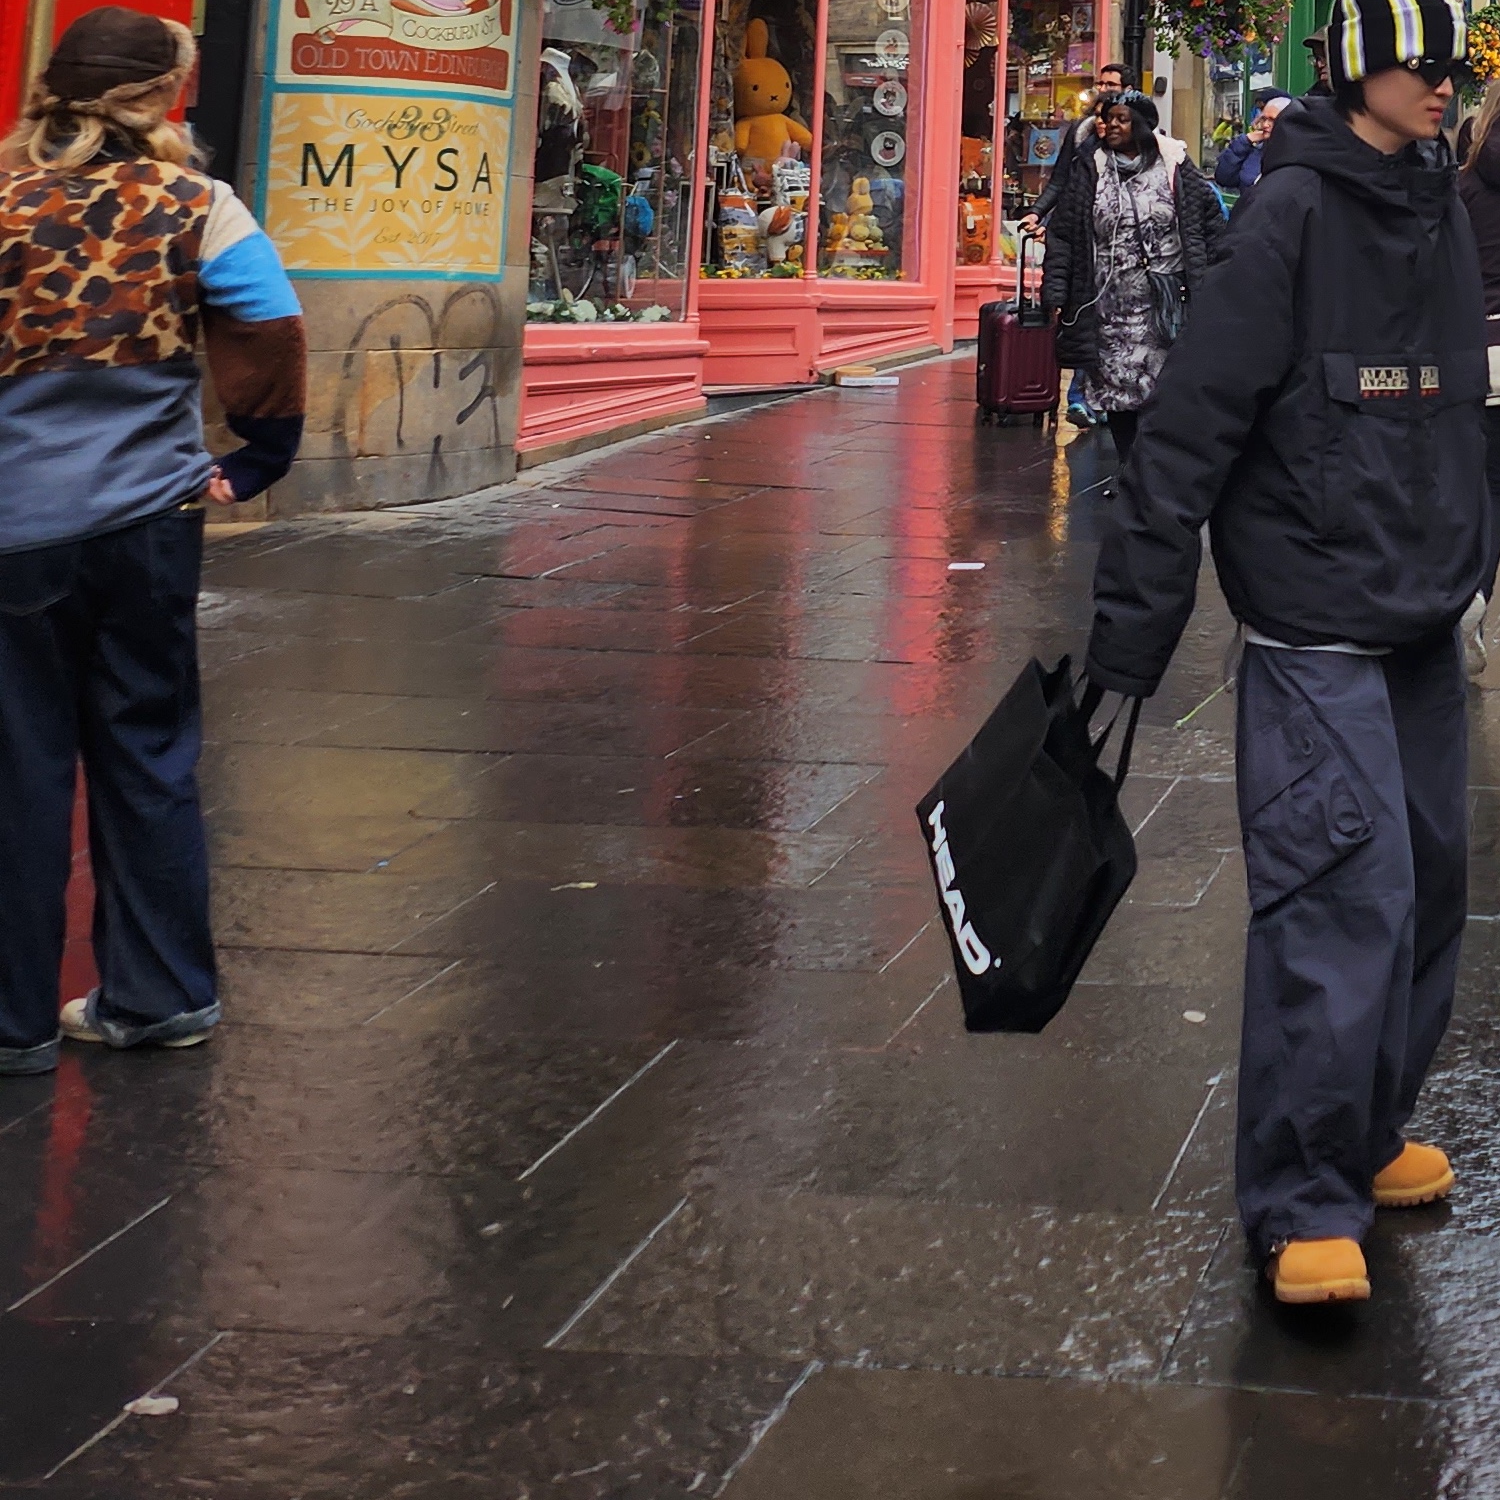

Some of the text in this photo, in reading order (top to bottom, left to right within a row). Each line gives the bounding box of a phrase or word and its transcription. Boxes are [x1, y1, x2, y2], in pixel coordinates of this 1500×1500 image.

[402, 19, 479, 42] COCKBURN
[297, 45, 349, 69] OLD
[355, 48, 419, 72] TOWN
[387, 106, 450, 142] 33
[300, 142, 493, 195] MYSA
[308, 198, 490, 217] THE JOY OF HOME
[928, 800, 990, 975] HEAD
